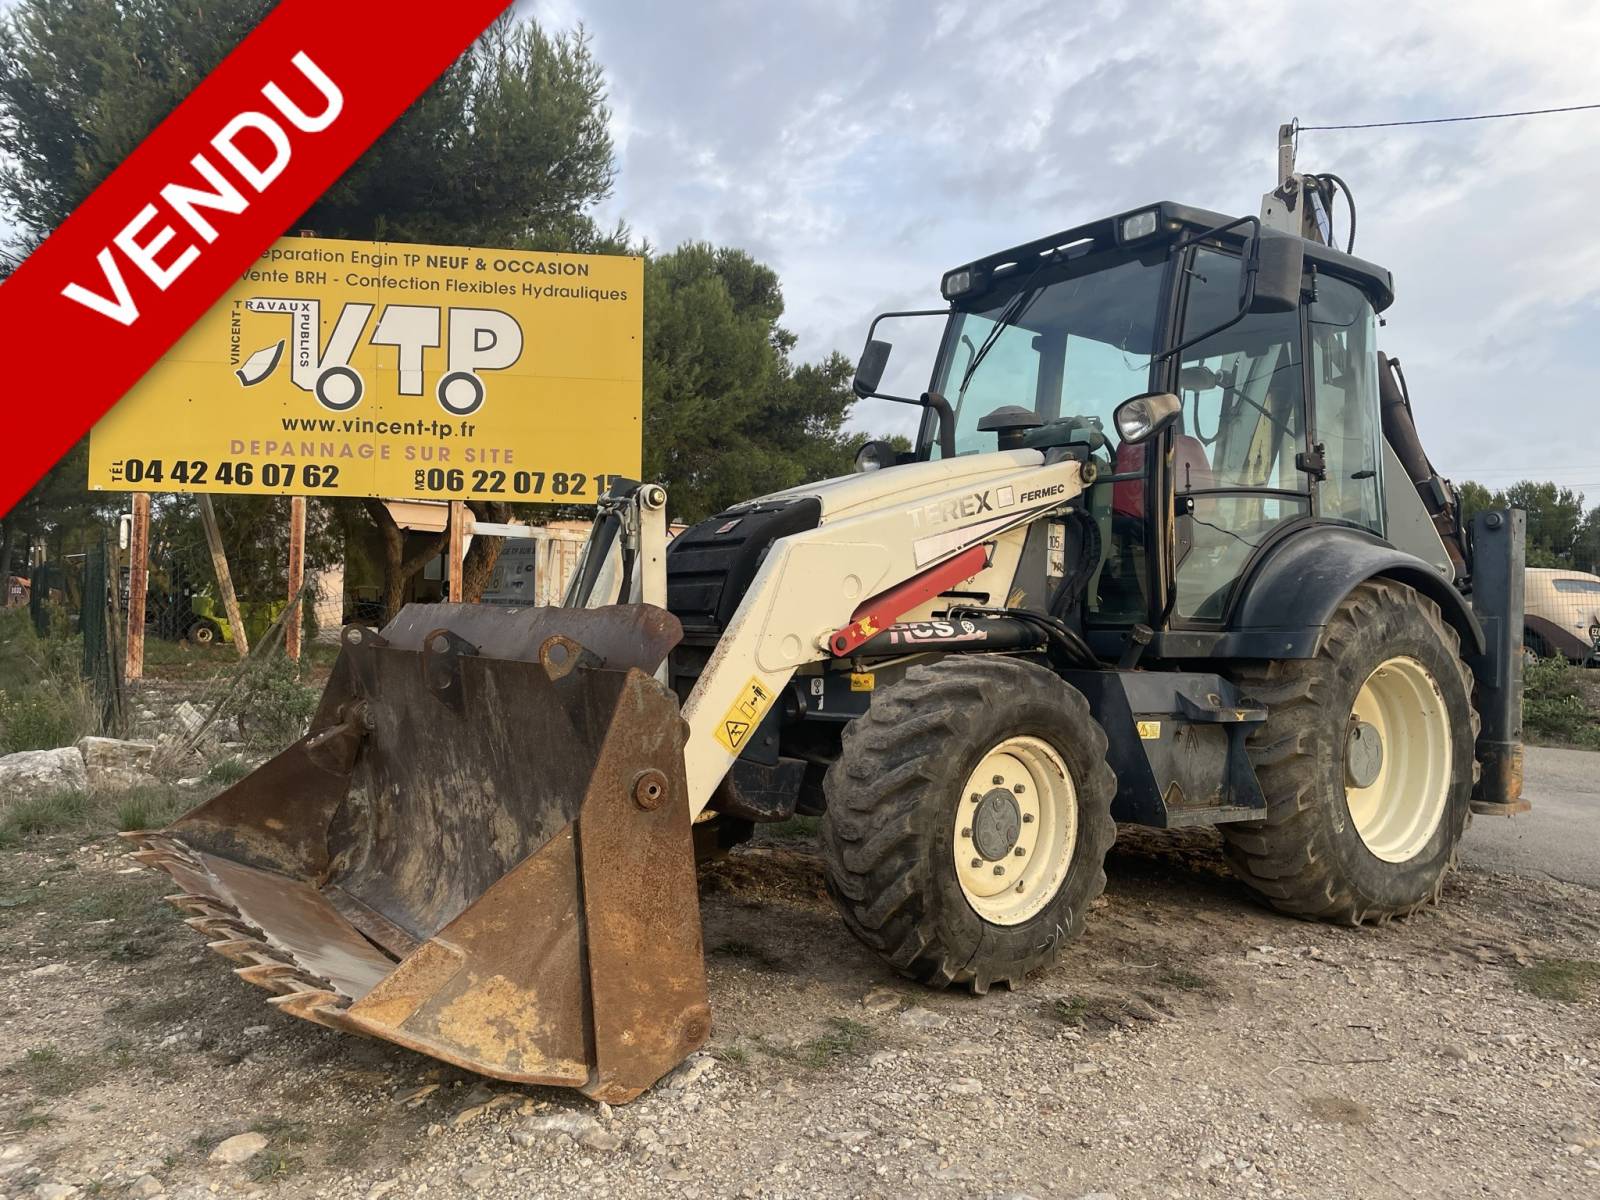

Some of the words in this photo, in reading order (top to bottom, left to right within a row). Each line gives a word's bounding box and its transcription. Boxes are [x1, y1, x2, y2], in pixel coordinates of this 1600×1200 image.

[261, 248, 345, 263] eparation
[351, 250, 398, 268] Engin
[403, 253, 421, 267] TP
[426, 255, 469, 270] NEUF
[475, 258, 487, 271] &
[493, 259, 589, 277] OCCASION
[242, 268, 289, 283] Vente
[295, 270, 327, 285] BRH
[345, 273, 440, 291] Confection
[445, 278, 516, 296] Flexibles
[522, 283, 628, 302] Hydrauliques
[234, 300, 310, 312] TRAVAUX
[231, 310, 241, 366] VINCENT
[300, 313, 310, 367] PUBLICS
[292, 297, 524, 411] VTP
[282, 417, 476, 439] www.vincent-tp.fr
[230, 439, 391, 460] DEPANNAGE
[404, 445, 451, 462] SUR
[464, 448, 514, 464] SITE
[125, 458, 164, 483] 04
[170, 460, 208, 484] 42
[214, 462, 254, 486] 46
[261, 463, 296, 487] 07
[302, 464, 340, 488] 62
[427, 468, 465, 492] 06
[471, 469, 506, 493] 22
[513, 471, 546, 494] 07
[552, 472, 587, 496] 82
[907, 490, 993, 529] TEREX
[1019, 483, 1065, 503] FERMEC
